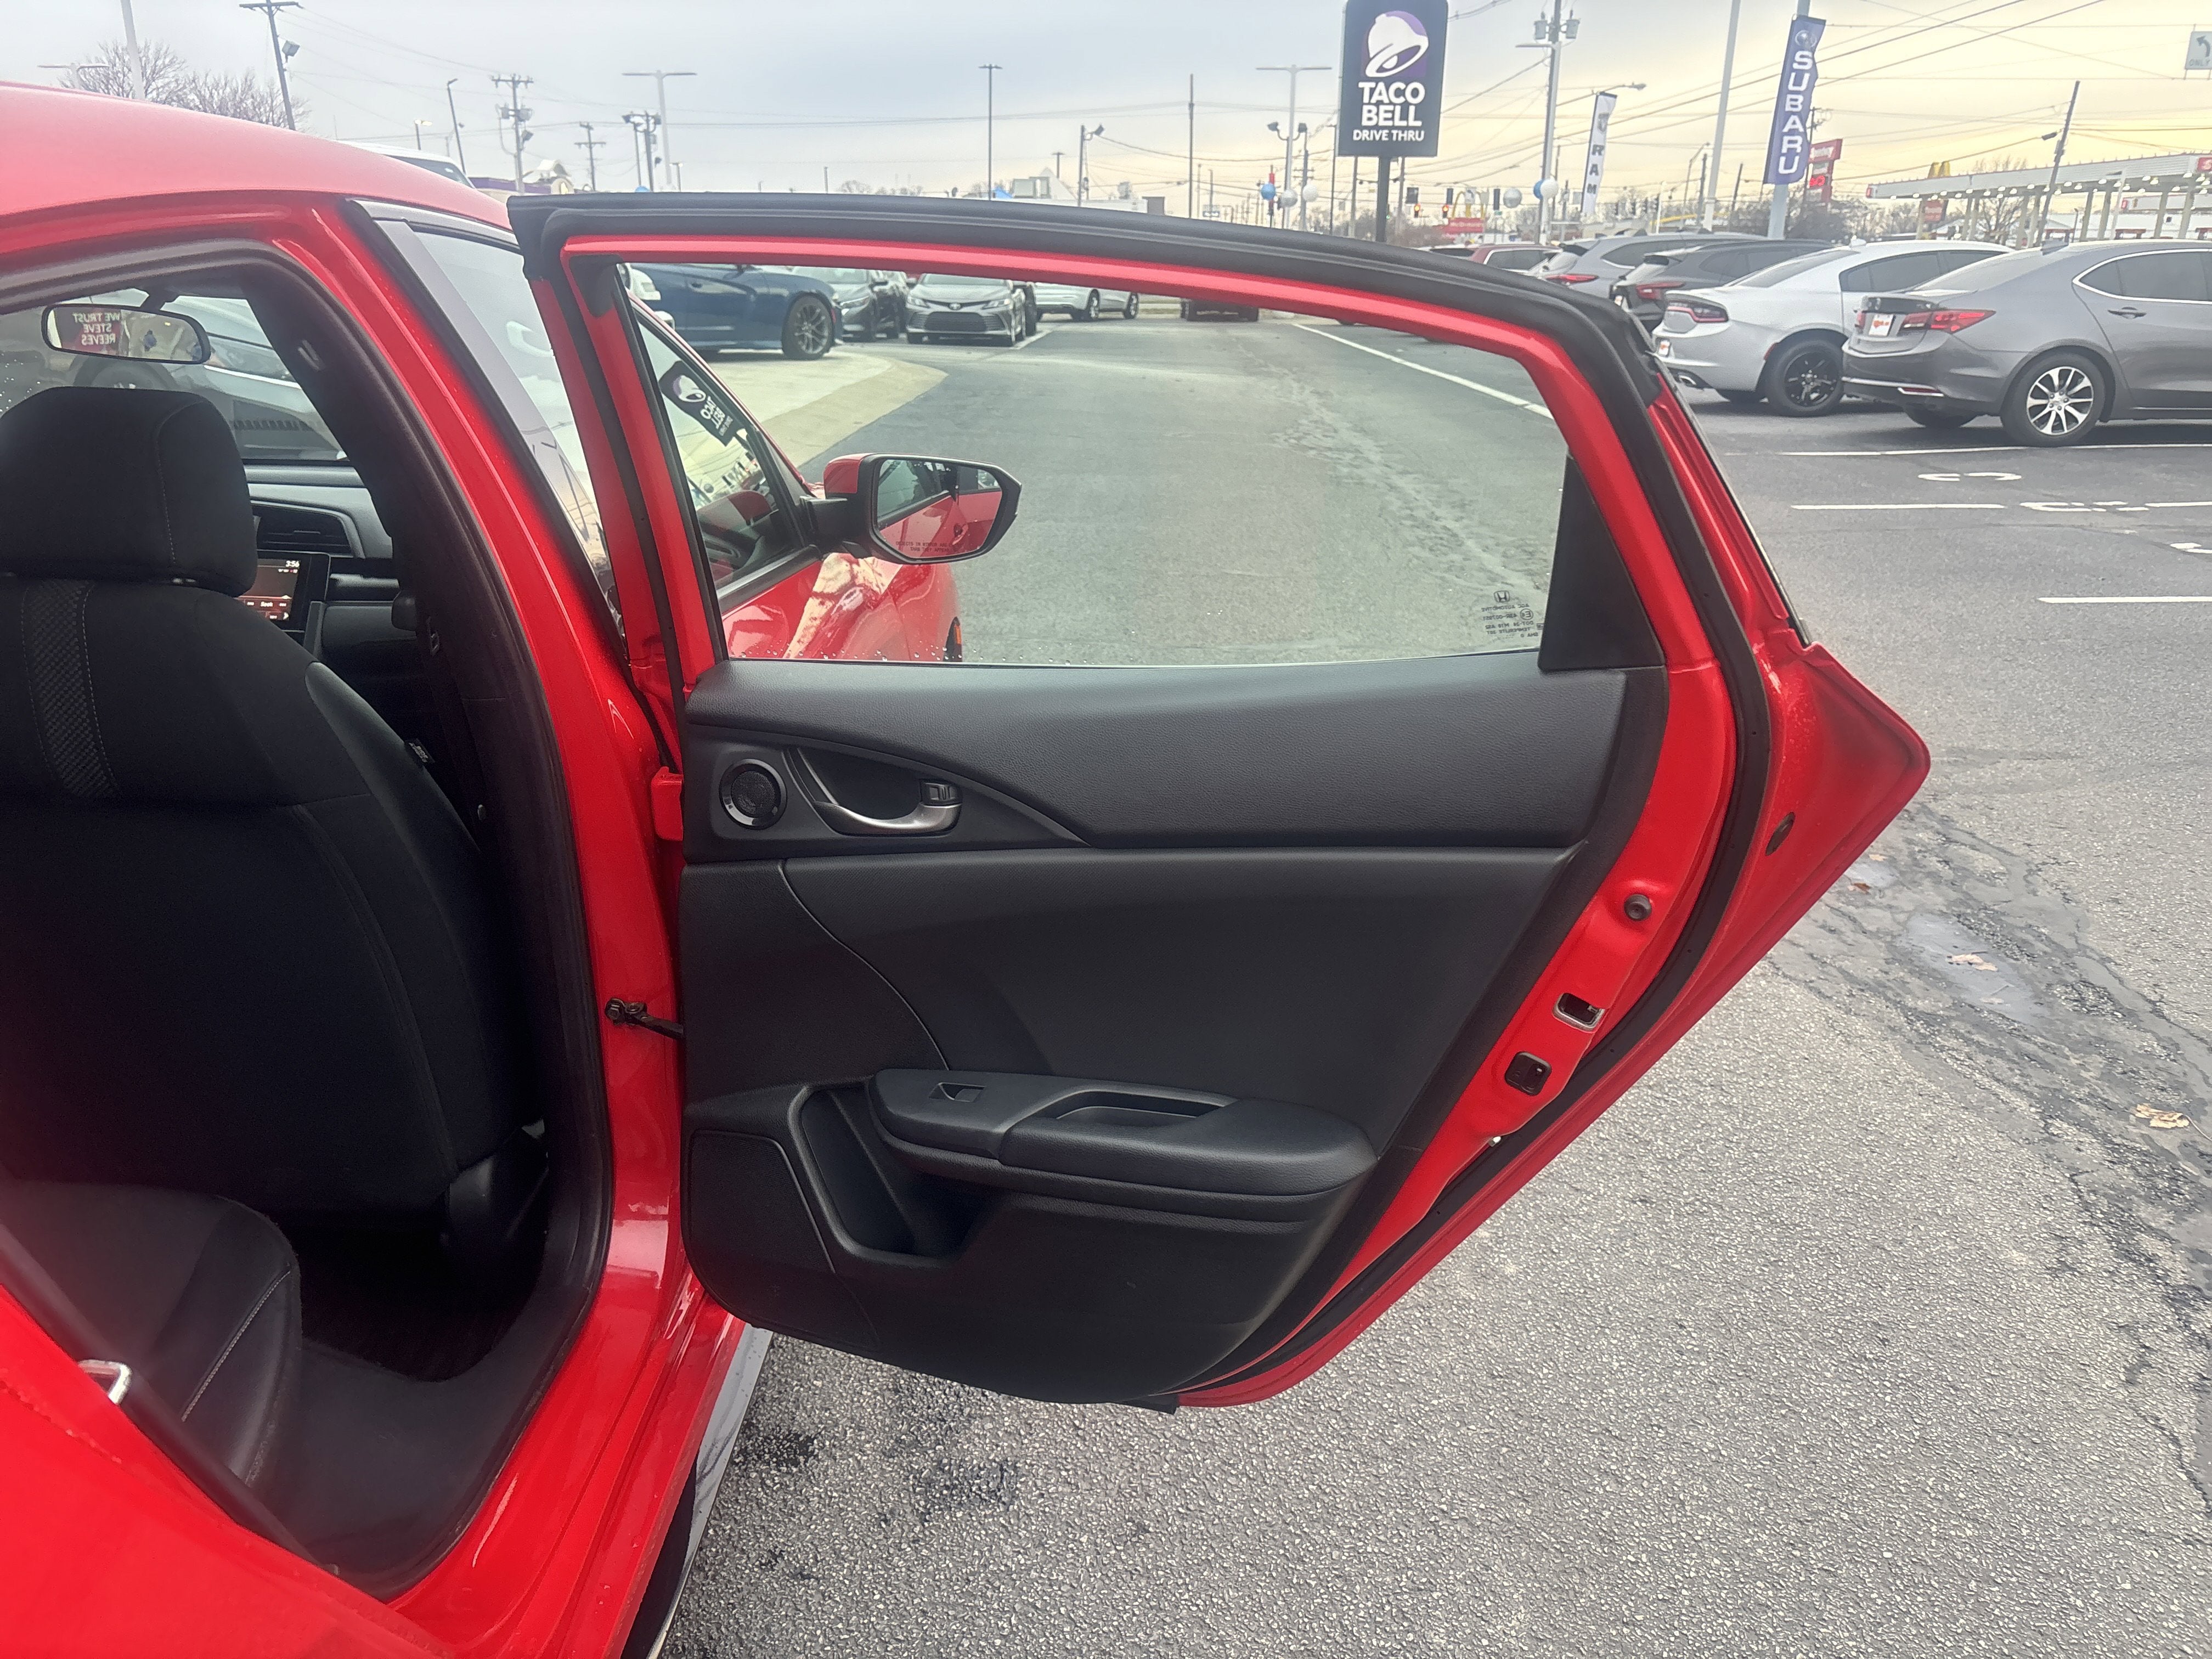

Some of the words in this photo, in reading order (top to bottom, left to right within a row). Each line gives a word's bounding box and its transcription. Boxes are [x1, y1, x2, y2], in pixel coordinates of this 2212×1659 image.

[1358, 81, 1425, 104] TACO
[1361, 105, 1423, 126] BELL
[1778, 50, 1813, 174] SUBARU
[1352, 129, 1389, 141] DRIVE
[1391, 130, 1425, 142] THRU
[1587, 144, 1605, 195] RAM
